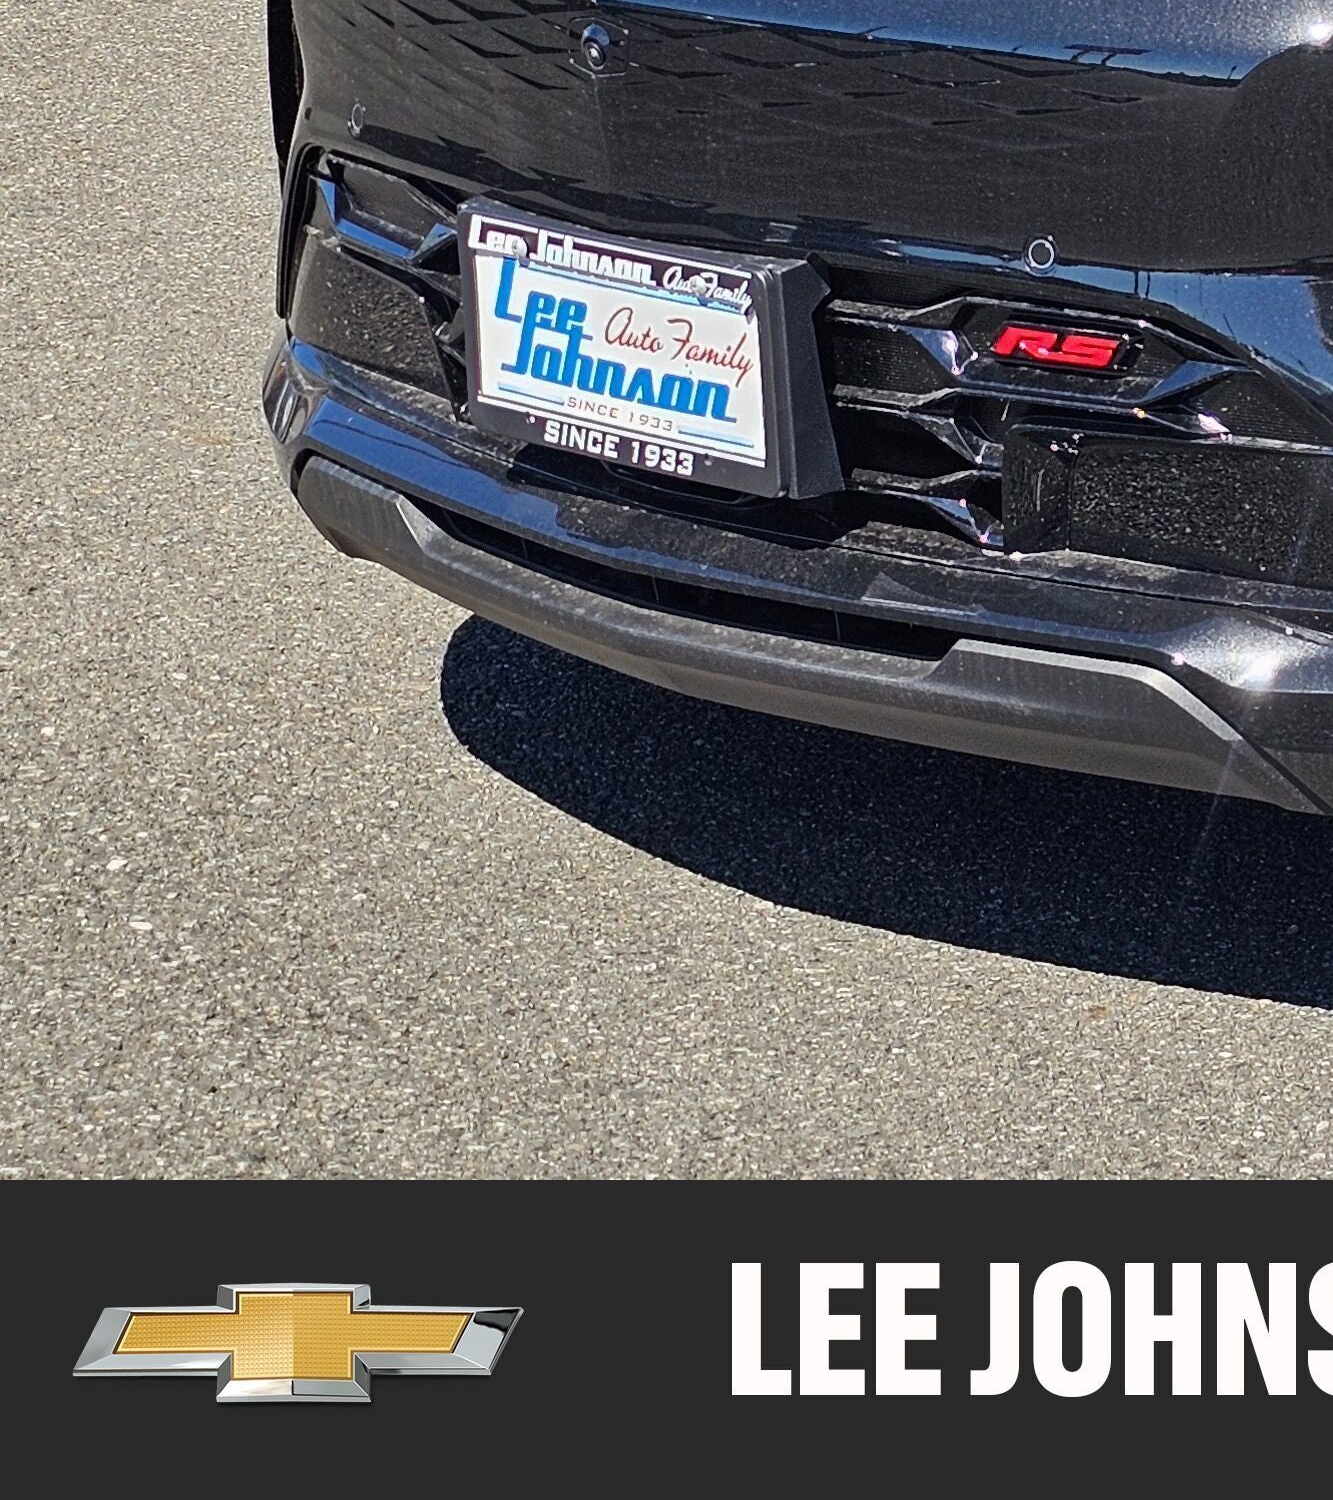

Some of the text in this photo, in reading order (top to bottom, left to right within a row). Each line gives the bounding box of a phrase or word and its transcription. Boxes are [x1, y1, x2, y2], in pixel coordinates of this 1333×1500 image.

[495, 257, 593, 341] Lee
[529, 227, 657, 287] Johnson
[663, 265, 704, 294] Aut
[699, 272, 753, 315] Family
[501, 318, 737, 423] Johnson
[605, 307, 754, 388] Auto Family
[990, 326, 1119, 368] RS
[543, 420, 694, 476] SINCE 1933
[567, 396, 673, 432] SINCE 1933
